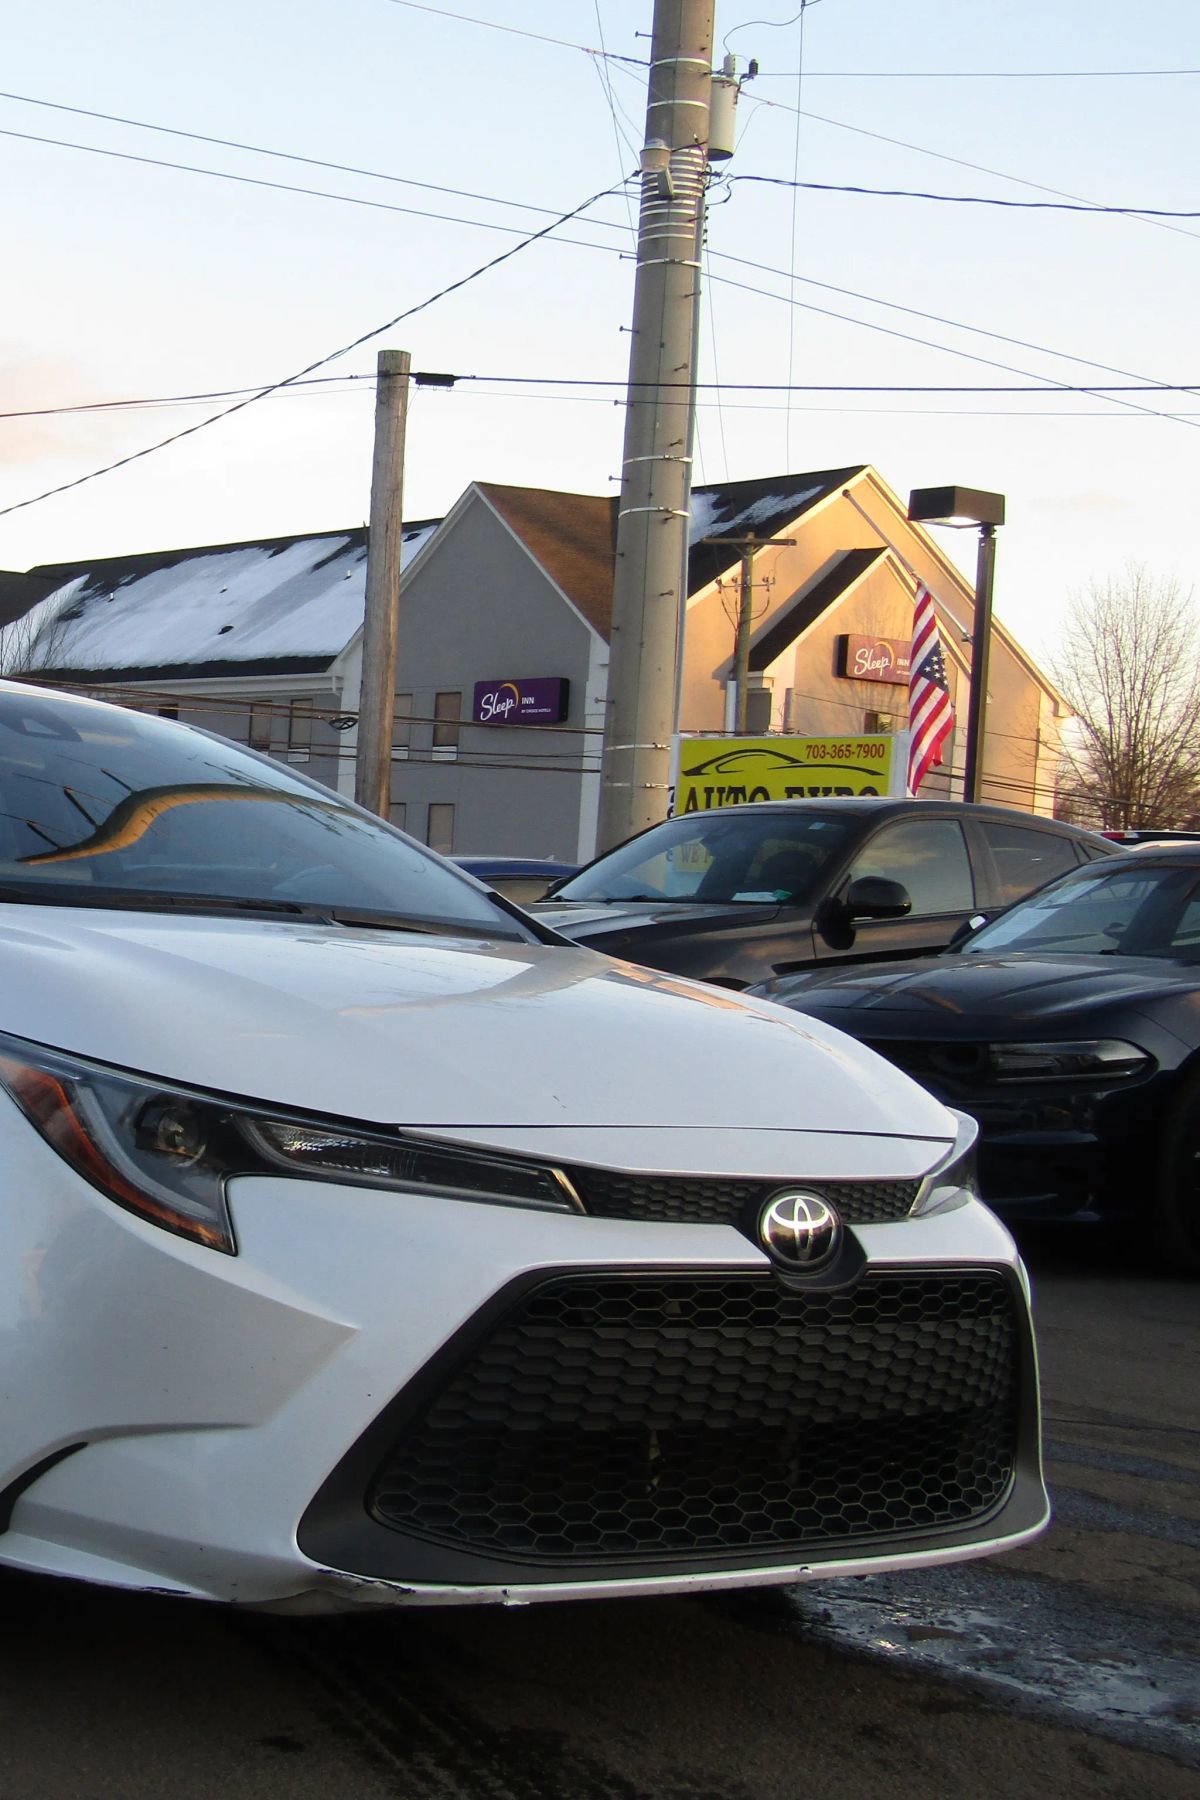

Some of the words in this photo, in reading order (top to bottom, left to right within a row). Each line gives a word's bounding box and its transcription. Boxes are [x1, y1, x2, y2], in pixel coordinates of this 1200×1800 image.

[854, 648, 890, 676] Sleep
[480, 692, 514, 720] Sleep
[521, 696, 535, 705] INN
[805, 743, 885, 760] 703-365-7900
